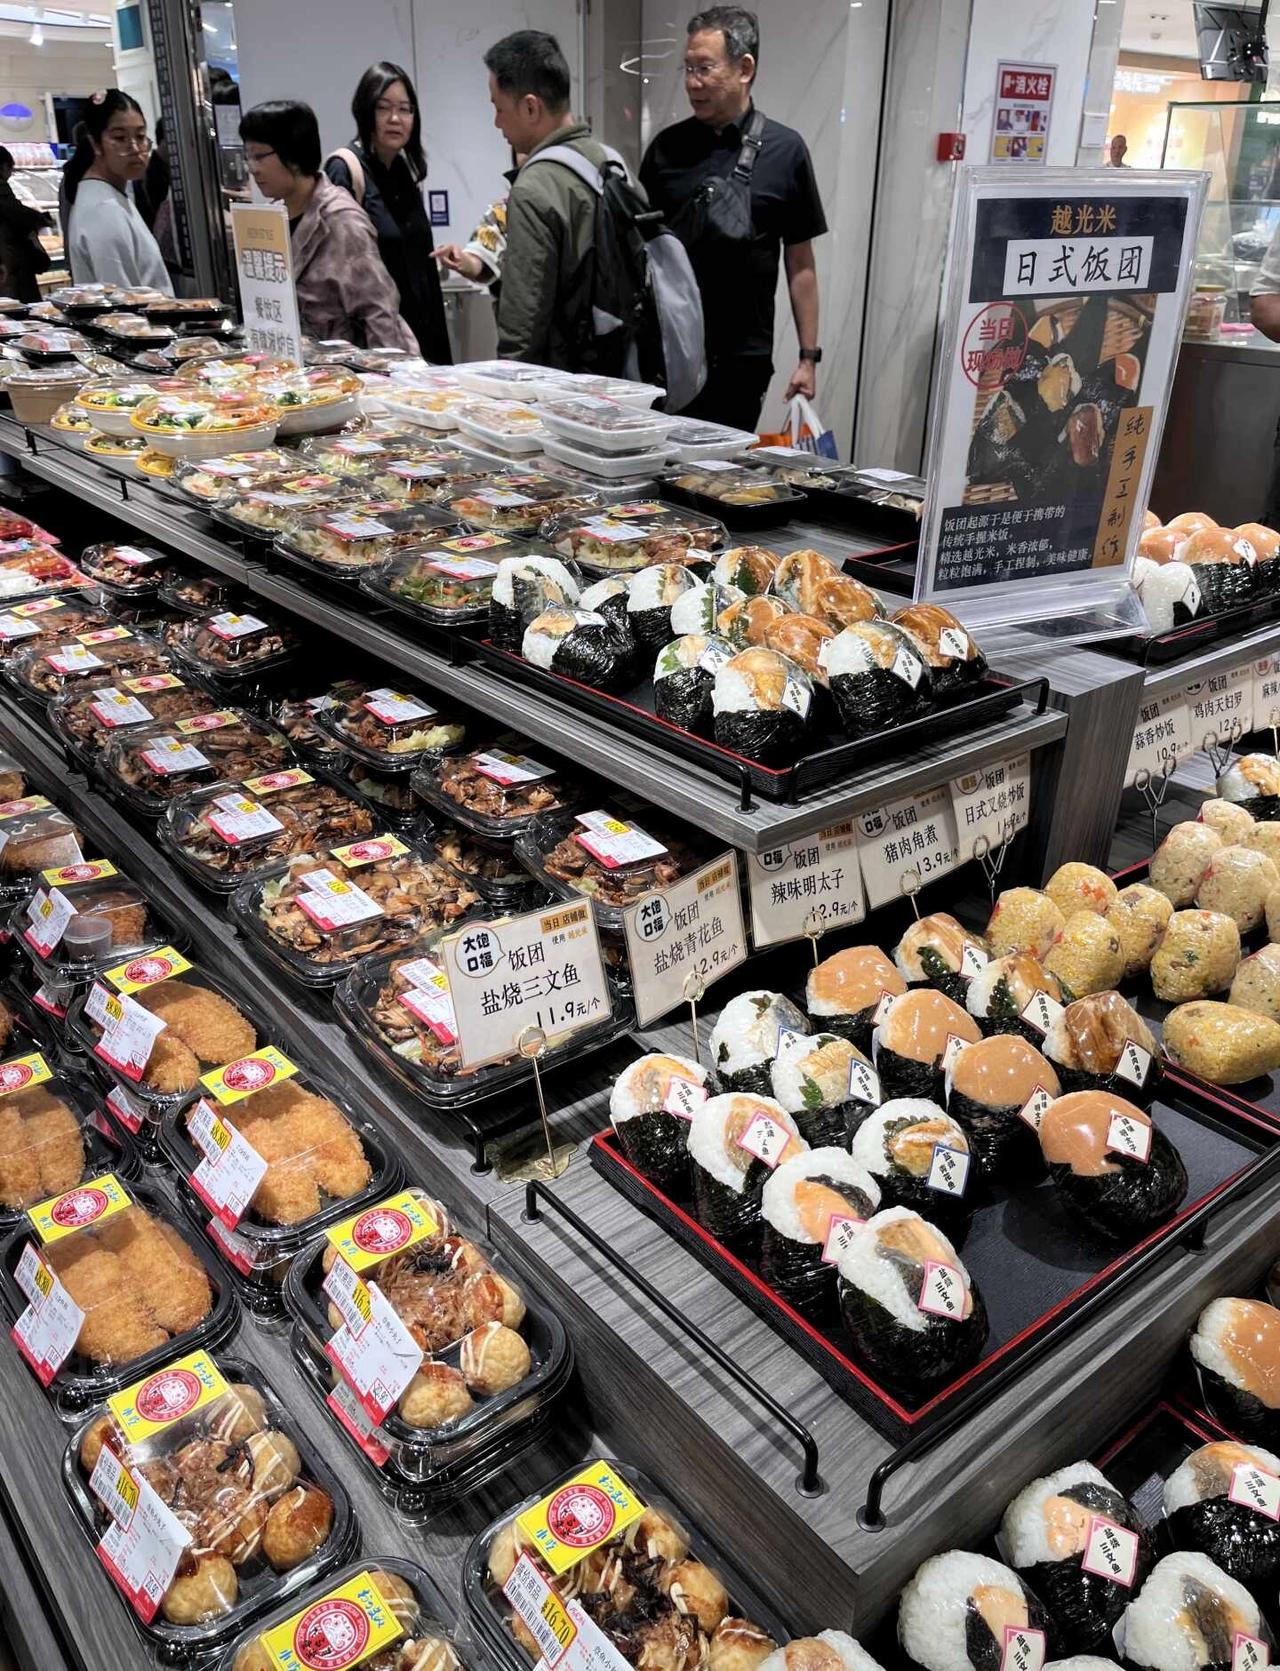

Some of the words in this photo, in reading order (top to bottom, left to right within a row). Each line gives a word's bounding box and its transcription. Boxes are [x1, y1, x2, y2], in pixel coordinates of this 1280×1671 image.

[1015, 75, 1049, 95] 消火栓
[1051, 204, 1117, 234] 越光米
[1017, 244, 1143, 287] 日式饭团
[979, 318, 1016, 341] 当日
[1102, 415, 1146, 559] 纯手工制作
[1208, 675, 1228, 693] 饭团
[1140, 702, 1160, 723] 饭团
[1134, 718, 1175, 750] 蒜香炒饭
[985, 767, 1005, 790] 饭团
[892, 805, 918, 831] 饭团
[884, 824, 939, 864] 猪肉角煮
[763, 850, 784, 866] 口福
[794, 846, 820, 870] 饭团
[771, 868, 844, 906] 辣味明太子
[543, 917, 560, 930] 当日
[641, 900, 662, 921] 大饱
[674, 900, 699, 931] 饭团
[552, 934, 566, 945] 使用
[644, 917, 664, 937] 口福
[463, 933, 490, 953] 大饱
[654, 916, 725, 976] 盐烧青花鱼
[467, 951, 494, 972] 口福
[508, 941, 546, 972] 饭团
[480, 963, 581, 1016] 盐烧三文鱼
[537, 997, 600, 1028] 11.9元/个
[935, 1282, 955, 1312] 三文鱼
[1244, 1480, 1267, 1507] 三文鱼
[1103, 1527, 1121, 1549] 盐烧
[1099, 1542, 1122, 1574] 三文鱼
[541, 1599, 571, 1645] ¥16.70
